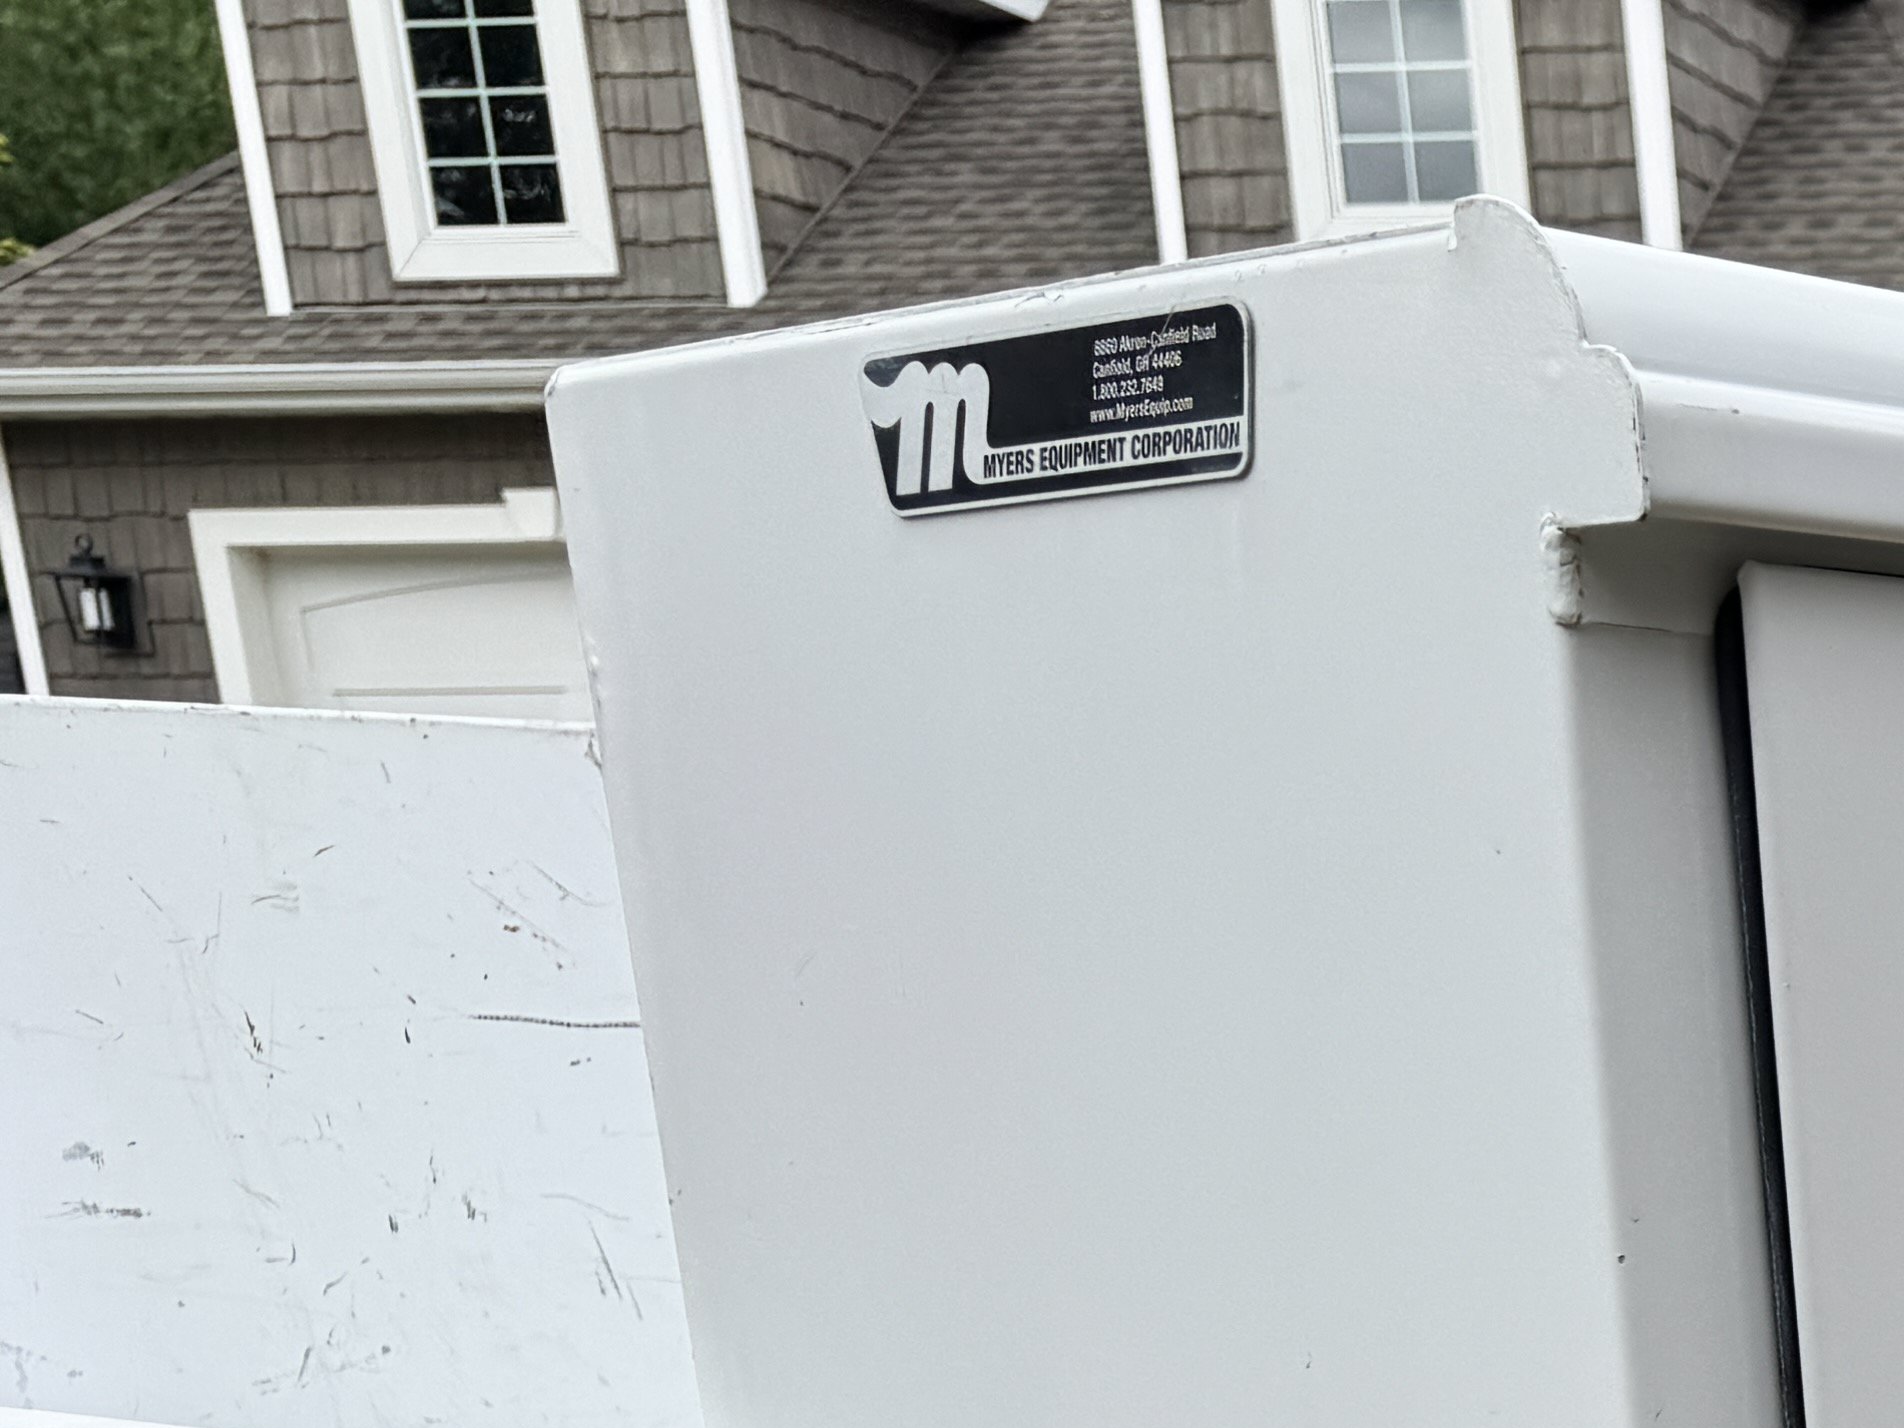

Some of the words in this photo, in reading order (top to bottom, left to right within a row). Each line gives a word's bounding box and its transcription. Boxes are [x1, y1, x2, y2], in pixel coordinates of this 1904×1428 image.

[983, 453, 1035, 479] MYERS
[1039, 436, 1126, 472] EQUIPMENT
[1131, 421, 1241, 460] CORPORATION
